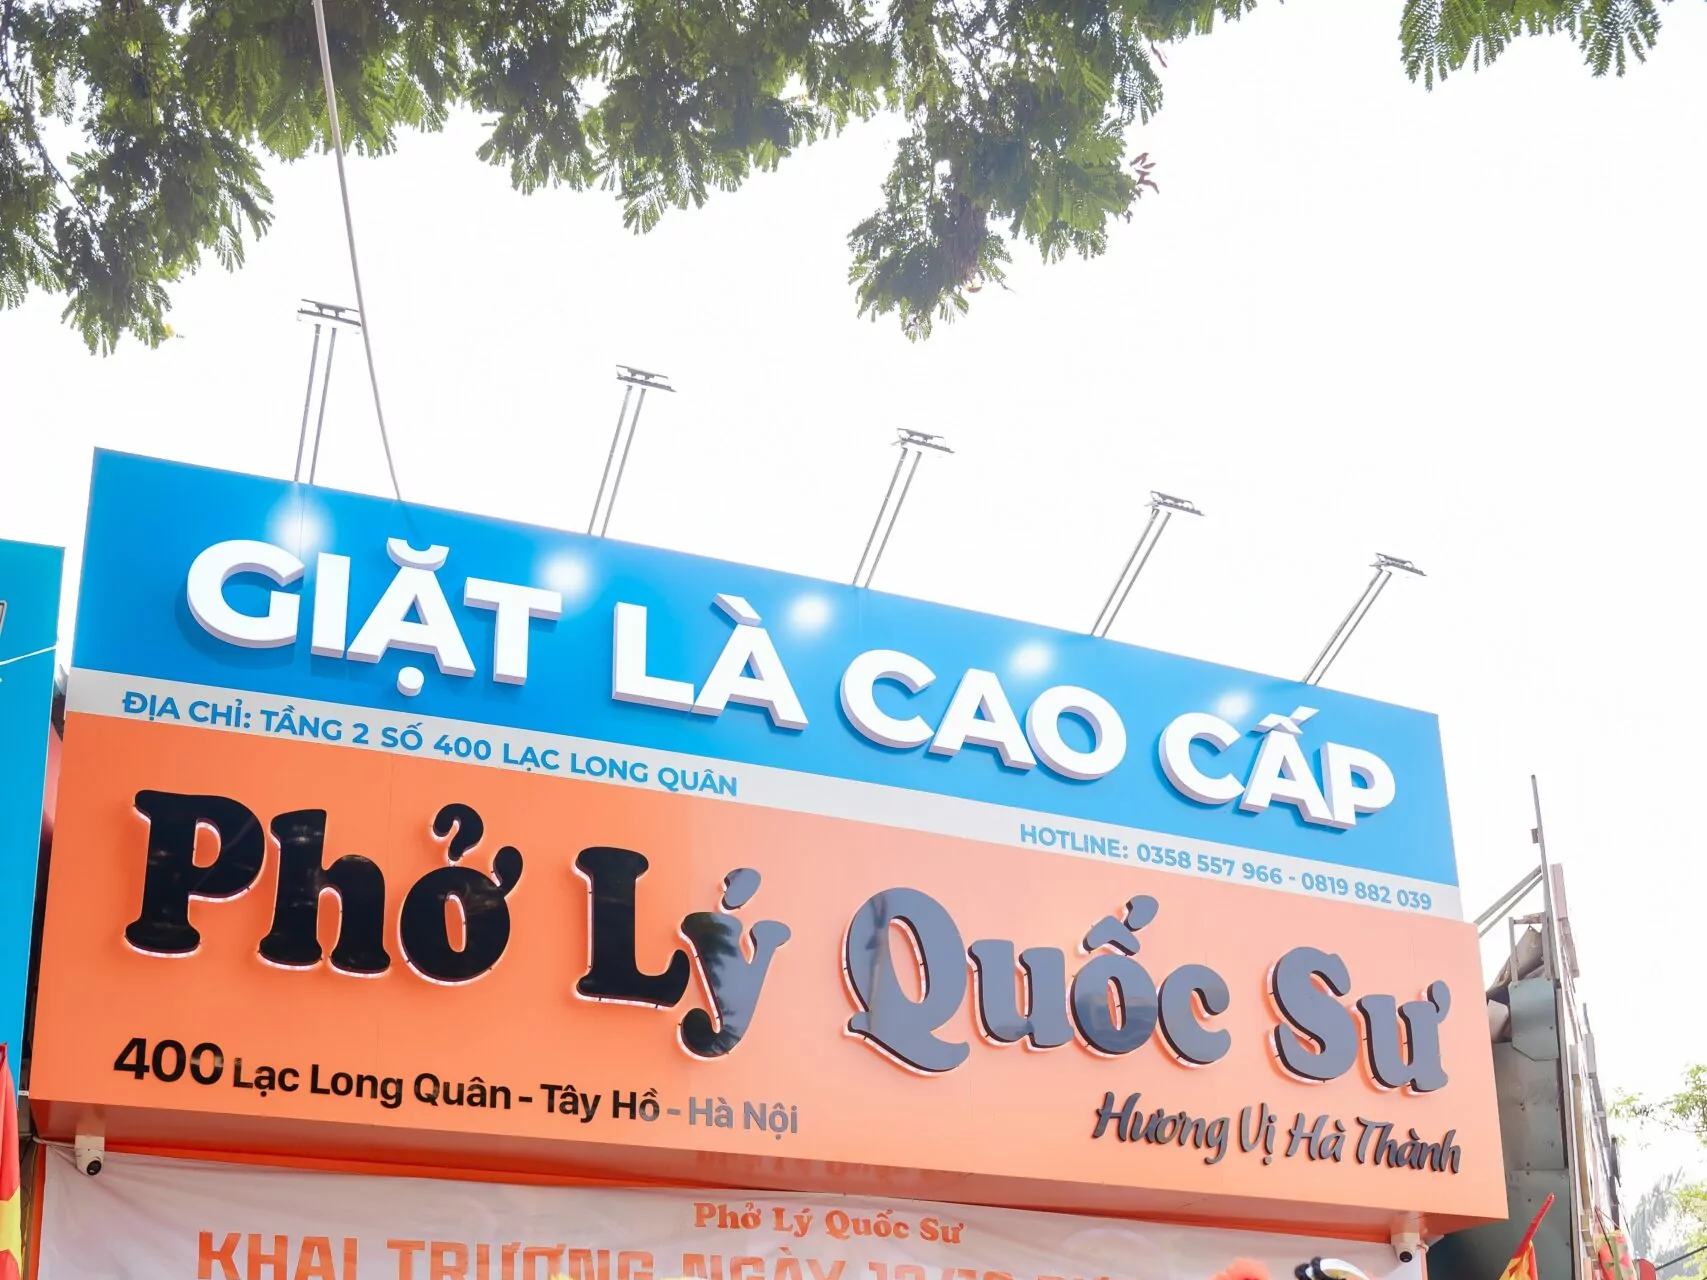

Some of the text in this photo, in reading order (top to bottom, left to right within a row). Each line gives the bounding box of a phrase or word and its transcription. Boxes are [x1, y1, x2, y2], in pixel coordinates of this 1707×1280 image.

[187, 537, 1396, 830] GIẶT LÀ CAO CẤP
[122, 691, 738, 799] ĐỊA CHỈ: TẦNG 2 SỐ 400 LẠC LONG QUÂN
[1020, 823, 1129, 860] HOTLINE:
[1136, 843, 1191, 871] 0358
[1197, 854, 1235, 878] 557
[1242, 862, 1283, 886] 966
[1301, 871, 1349, 896] 0819
[1355, 880, 1392, 906] 882
[1397, 888, 1432, 911] 039
[124, 789, 1452, 1096] Phở Lý Quốc Sư
[113, 1037, 225, 1086] 400
[233, 1056, 300, 1096] Lạc
[310, 1063, 403, 1109] Long
[413, 1072, 512, 1110] Quân
[540, 1083, 601, 1123] Tây
[611, 1087, 660, 1122] Hồ
[688, 1096, 734, 1129] Hà
[743, 1101, 798, 1140] Nội
[1092, 1091, 1461, 1174] Hương Vị Hà Thành
[693, 1202, 965, 1246] Phở Lý Quốc Sư
